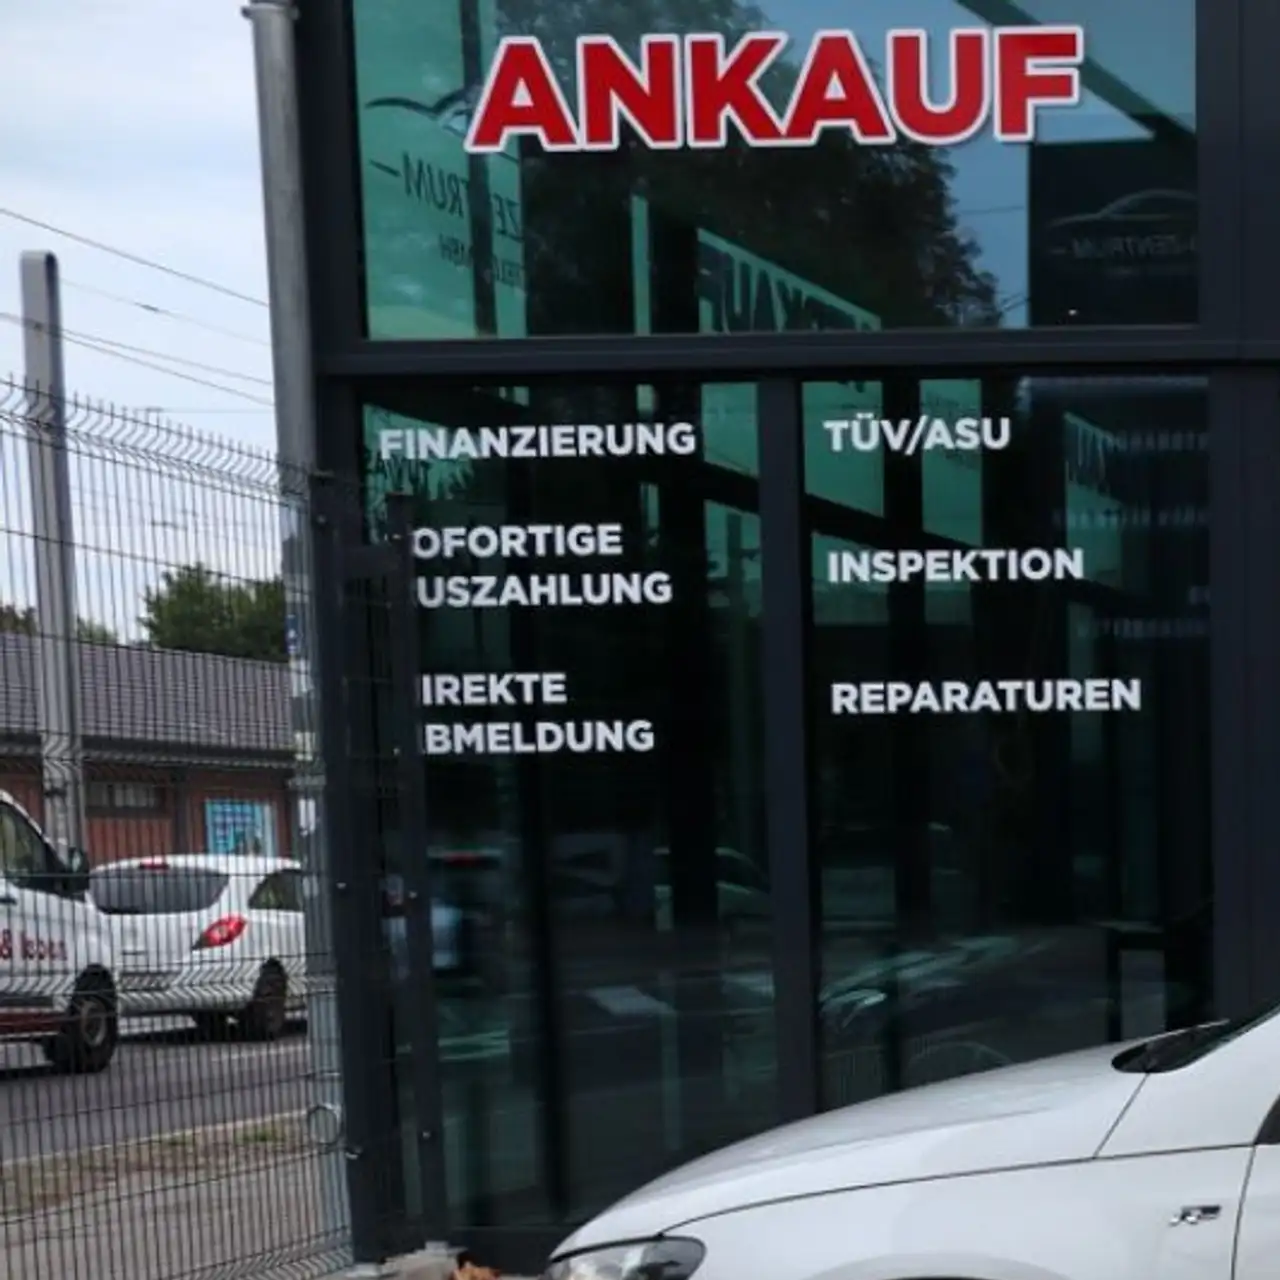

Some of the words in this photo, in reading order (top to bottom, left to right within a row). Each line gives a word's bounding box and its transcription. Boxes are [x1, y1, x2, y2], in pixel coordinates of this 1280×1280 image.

[466, 28, 1082, 152] ANKAUF
[378, 421, 697, 461] FINANZIERUNG
[822, 411, 1011, 456] TÜV/ASU
[411, 523, 623, 560] OFORTIGE
[827, 547, 1085, 583] INSPEKTION
[415, 571, 674, 609] USZAHLUNG
[421, 671, 568, 706] IREKTE
[831, 678, 1142, 715] REPARATUREN
[423, 718, 656, 755] BMELDUNG
